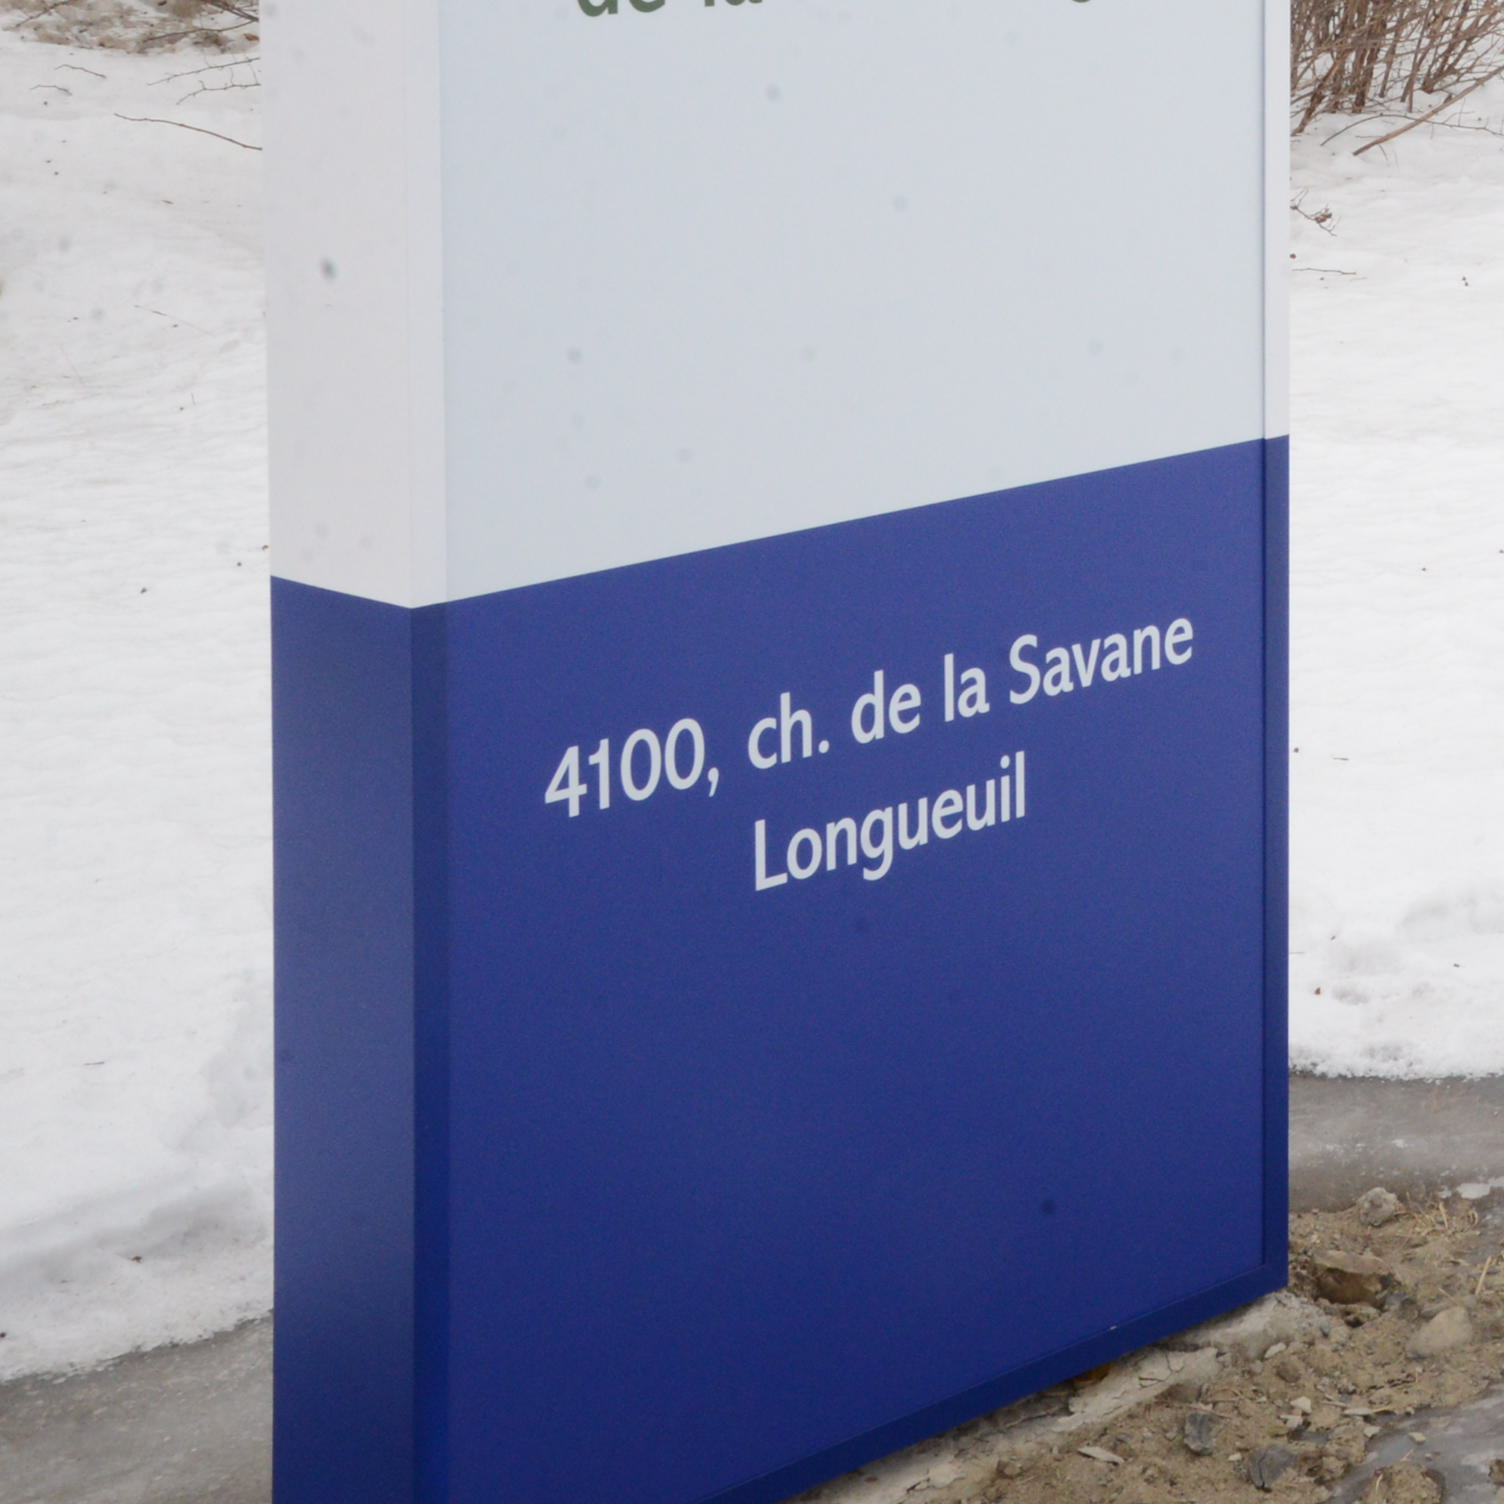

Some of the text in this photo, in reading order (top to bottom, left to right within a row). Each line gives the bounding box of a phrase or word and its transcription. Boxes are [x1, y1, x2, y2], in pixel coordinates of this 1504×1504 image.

[544, 617, 1194, 818] 4100, ch. de la Savane
[754, 750, 1026, 892] Longueuil
